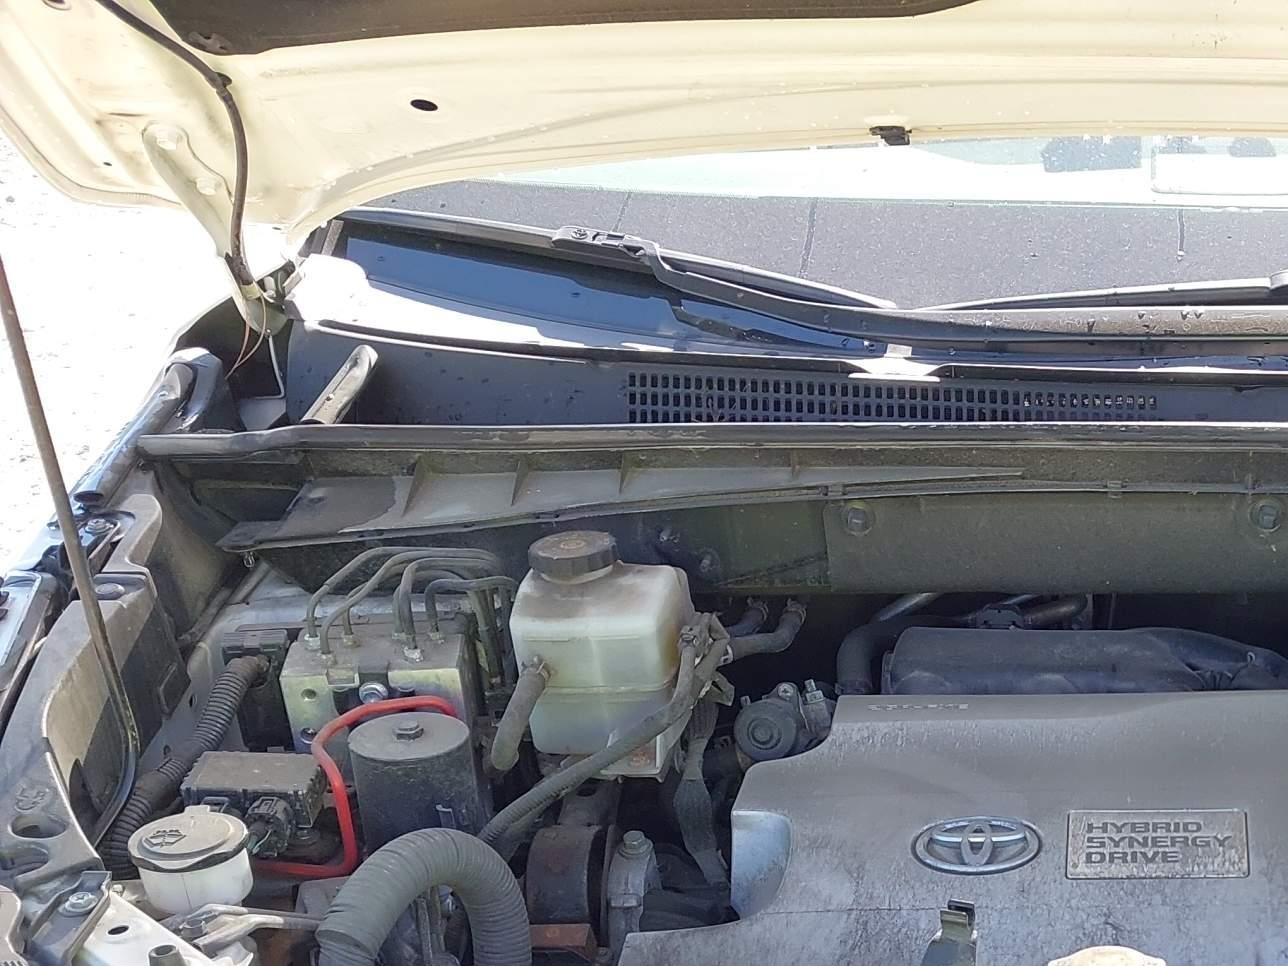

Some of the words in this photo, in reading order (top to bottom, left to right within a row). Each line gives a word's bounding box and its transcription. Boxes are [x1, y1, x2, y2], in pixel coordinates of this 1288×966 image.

[1086, 821, 1203, 834] HYBRID
[1086, 835, 1233, 849] SYNERGY
[1085, 851, 1181, 865] DRIVE
